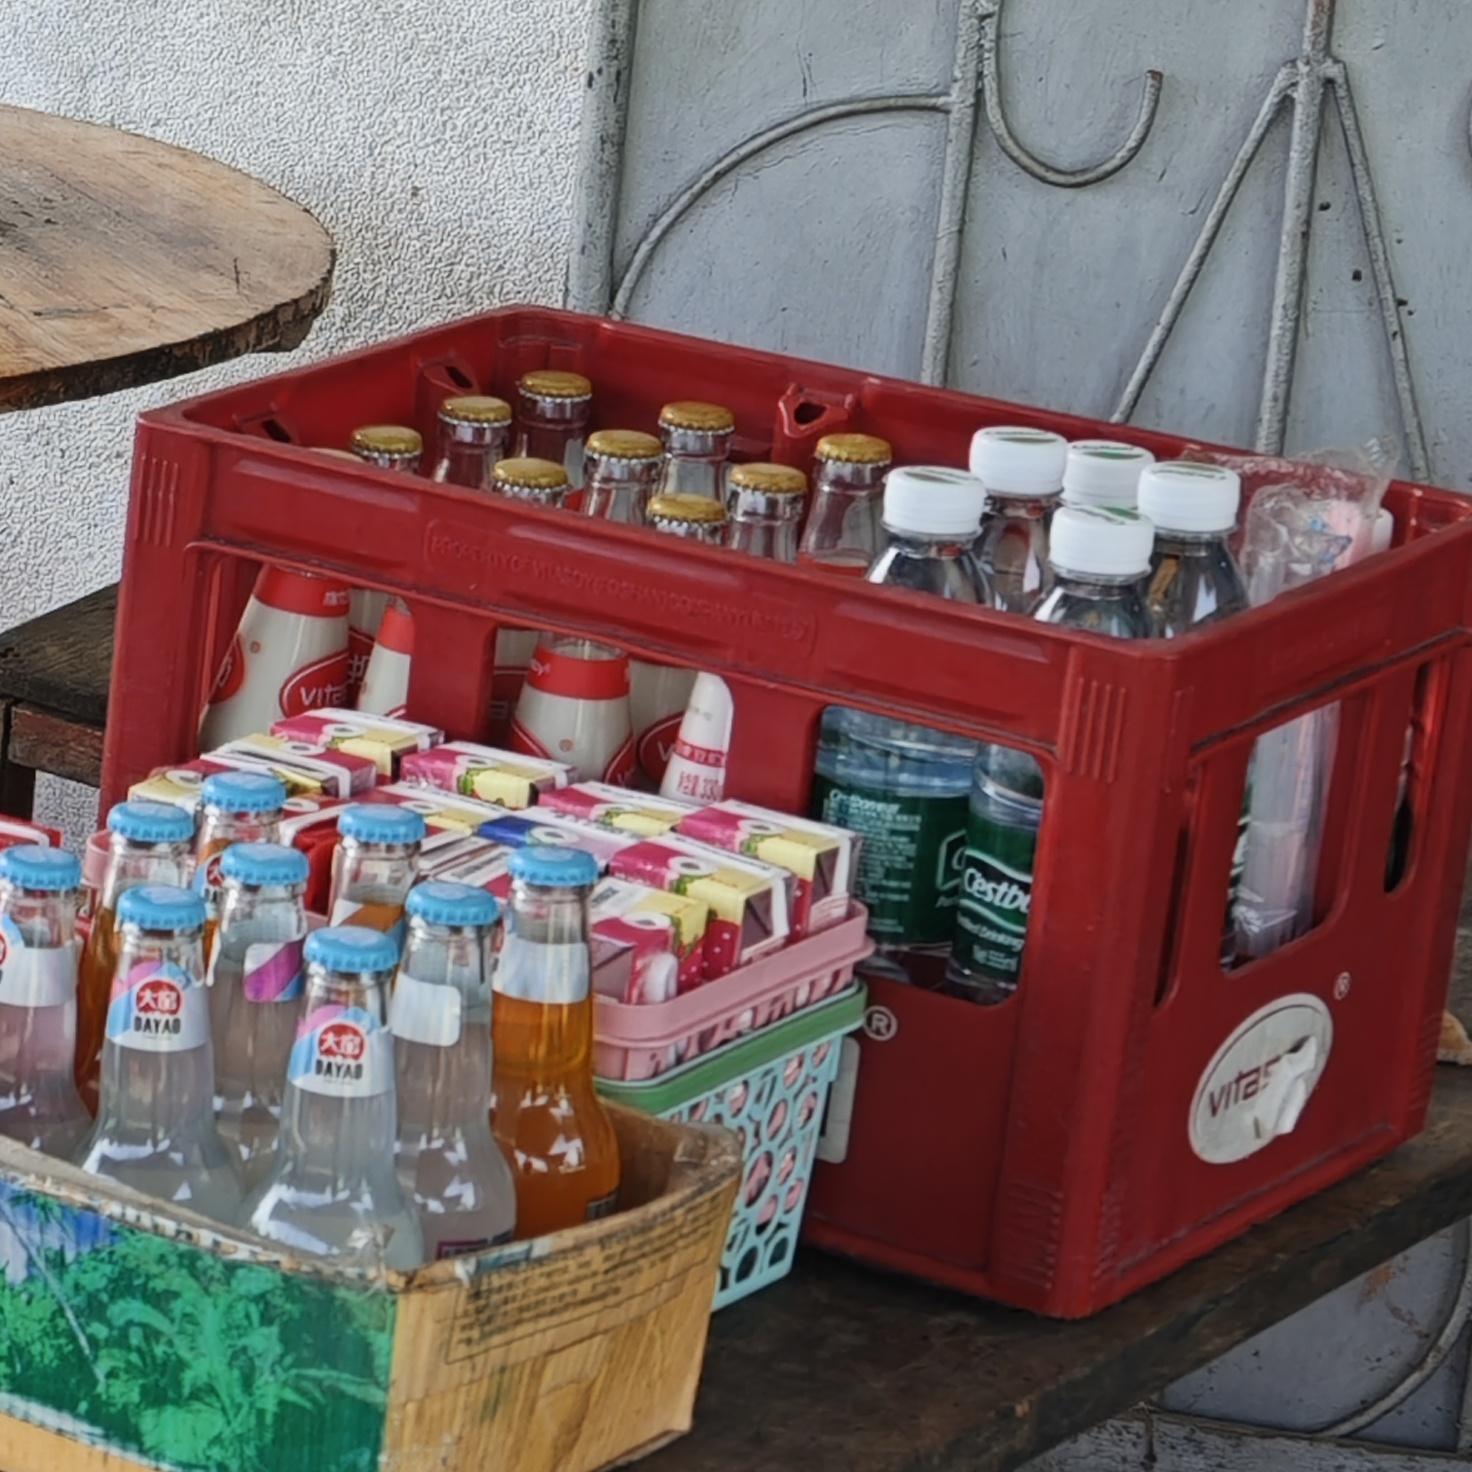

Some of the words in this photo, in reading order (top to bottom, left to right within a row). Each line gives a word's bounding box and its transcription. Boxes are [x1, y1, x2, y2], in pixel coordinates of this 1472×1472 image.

[138, 988, 178, 1012] 大窑
[134, 1016, 181, 1035] DAYAO
[320, 1029, 361, 1055] 大窑
[315, 1059, 364, 1080] DAYAO
